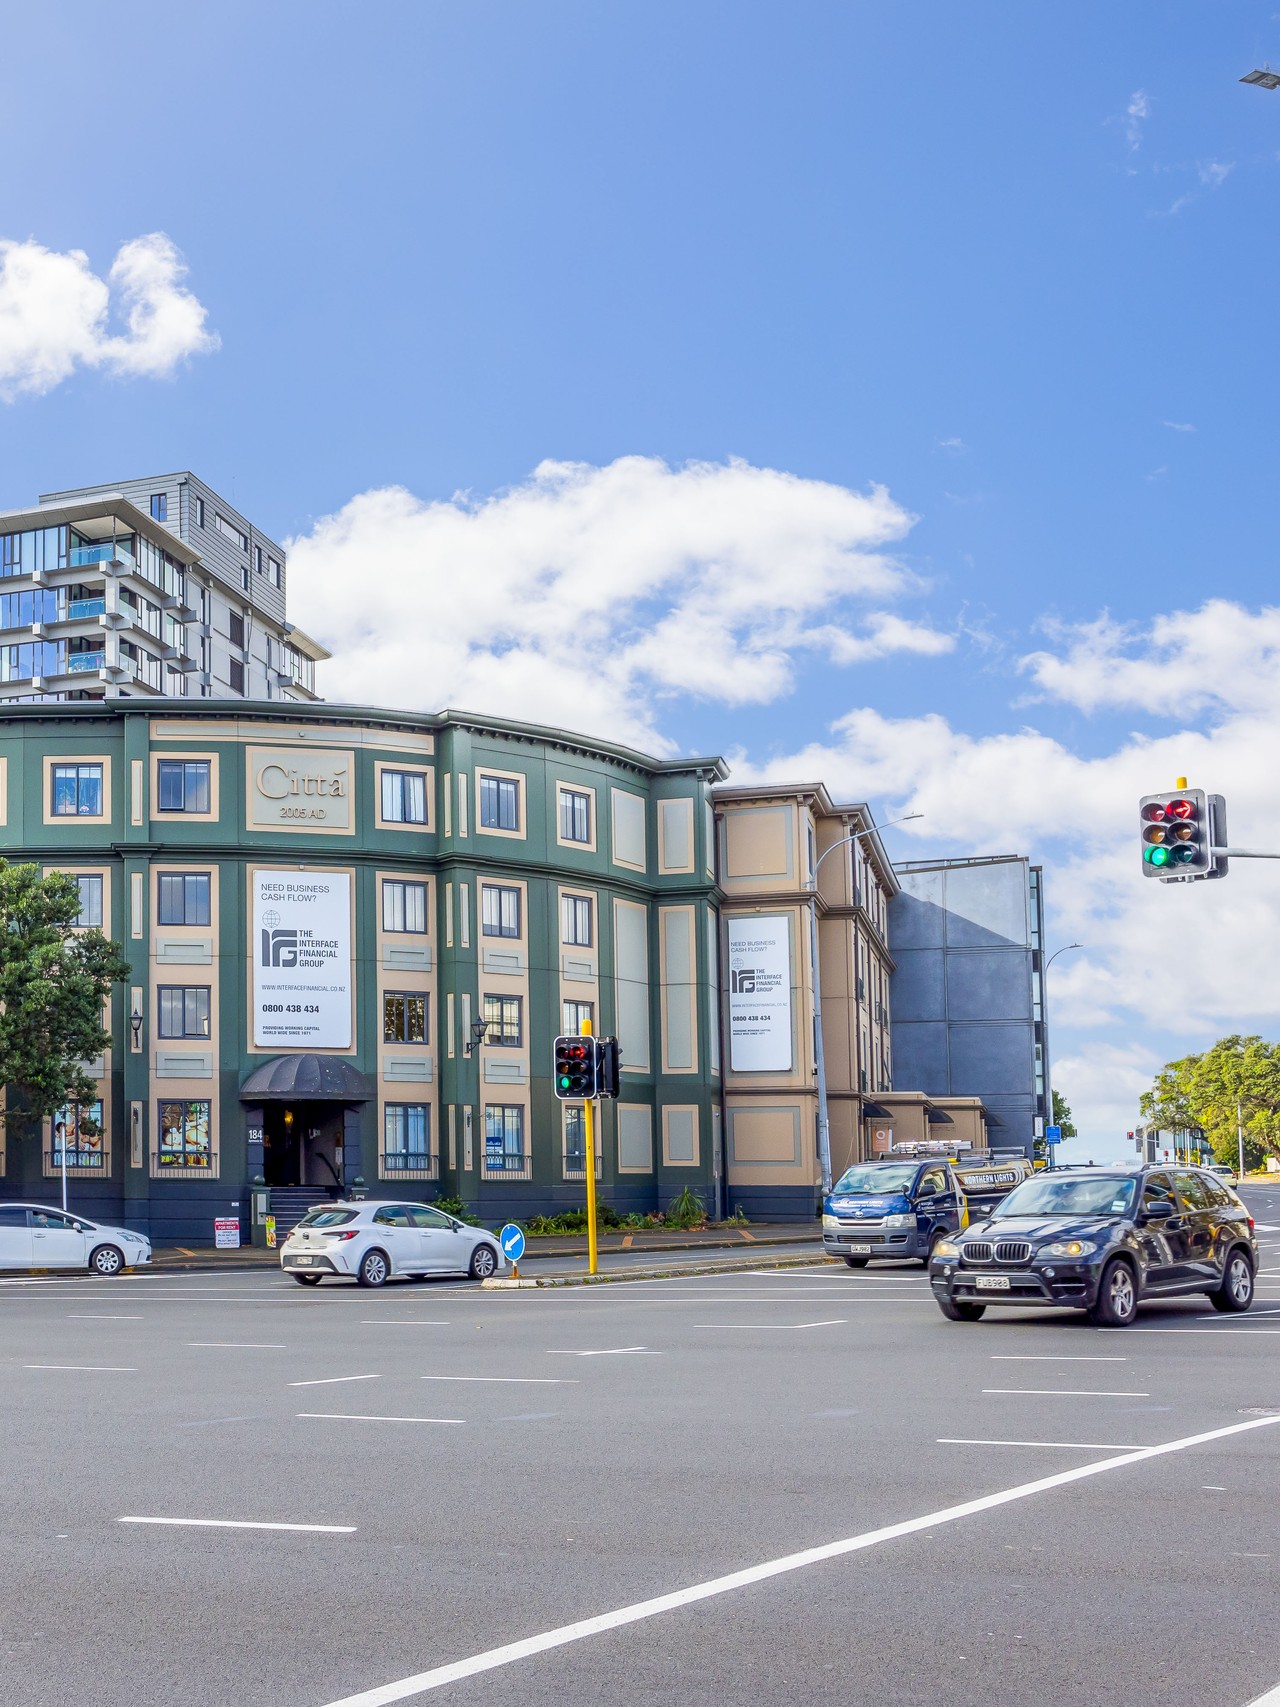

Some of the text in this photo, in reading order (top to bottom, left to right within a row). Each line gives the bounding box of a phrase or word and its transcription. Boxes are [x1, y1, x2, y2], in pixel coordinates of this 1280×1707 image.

[280, 807, 326, 820] 2005 AD
[261, 883, 330, 894] NEED BUSINESS
[261, 893, 317, 902] CASH FLOW?
[298, 929, 313, 938] THE
[299, 939, 339, 949] INTERFACE
[299, 949, 338, 959] FINANCIAL
[299, 959, 325, 968] GROUP
[262, 1004, 320, 1013] 0800 438 434
[248, 1129, 263, 1139] 184
[964, 1173, 1014, 1184] NORTHERN LIGHTS
